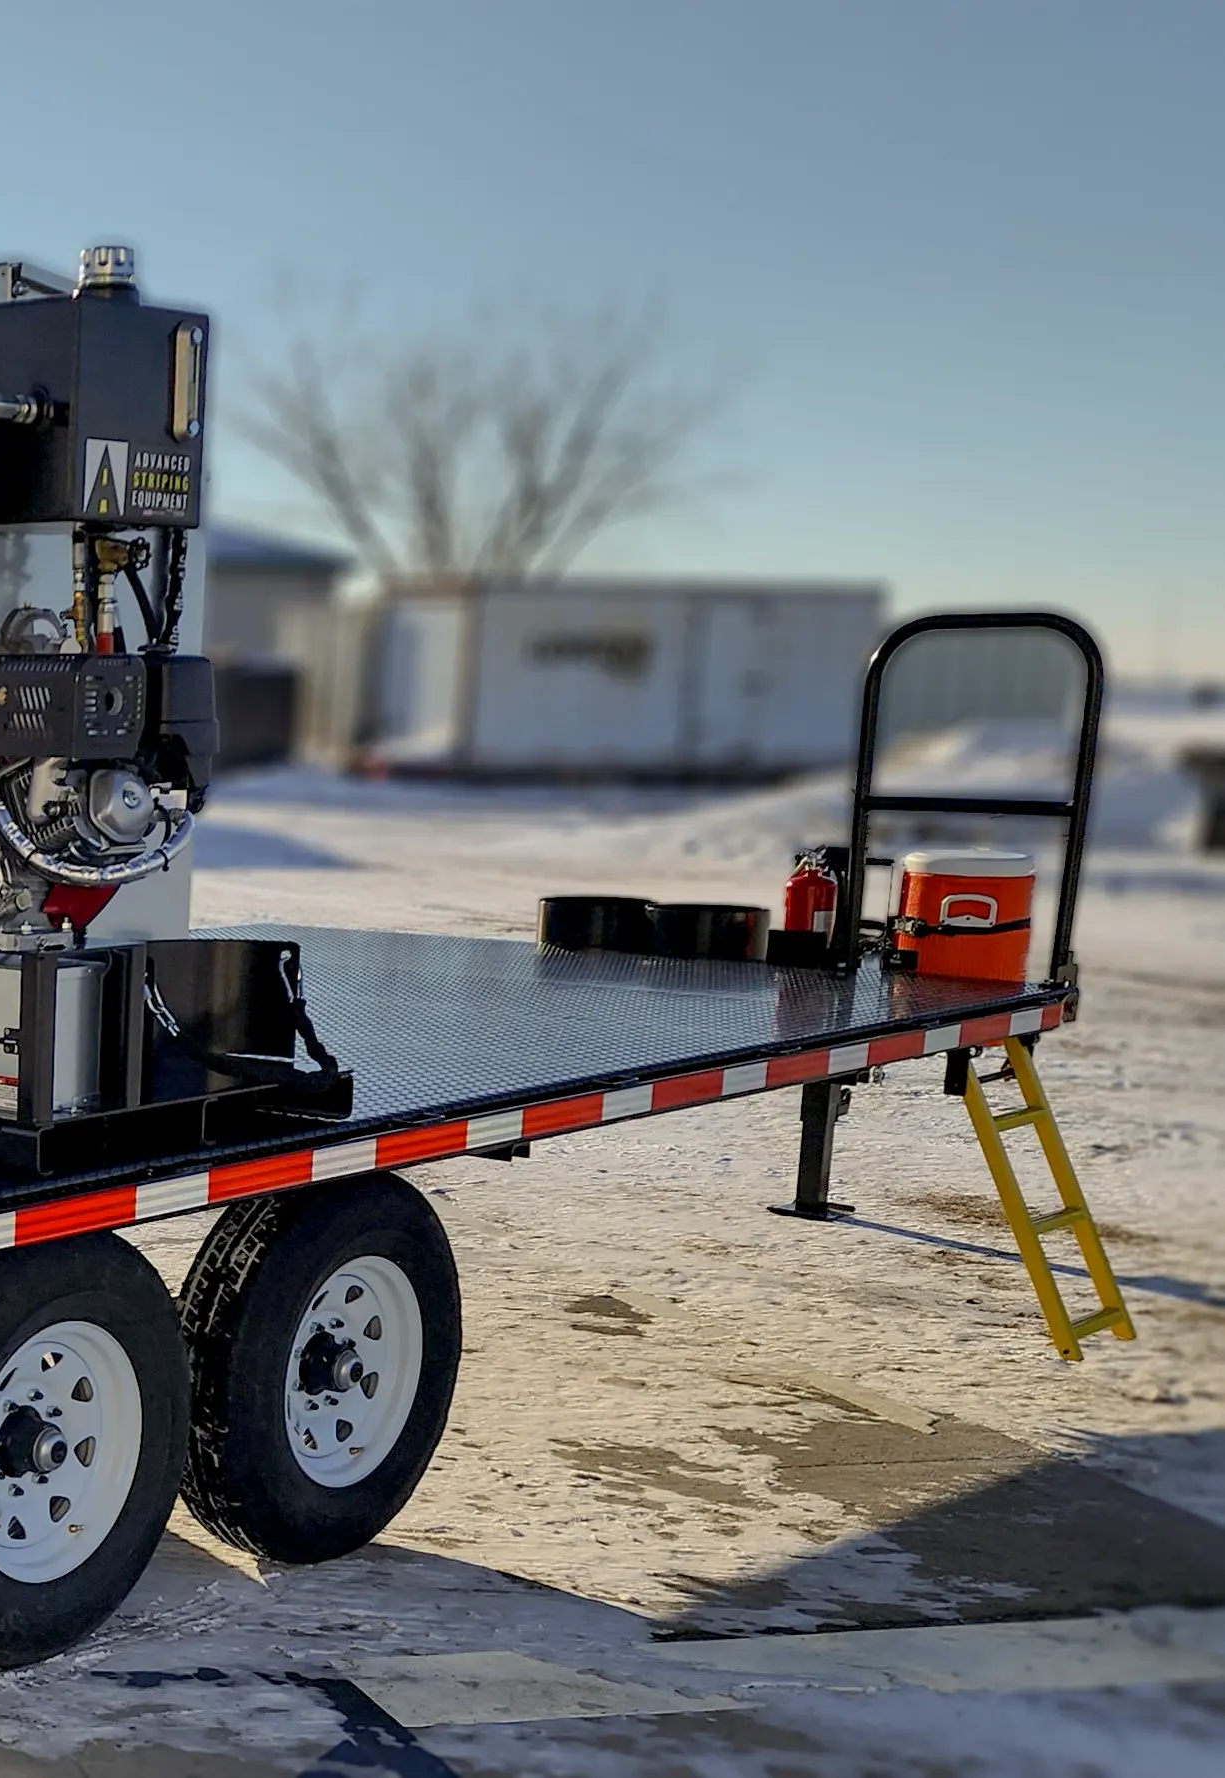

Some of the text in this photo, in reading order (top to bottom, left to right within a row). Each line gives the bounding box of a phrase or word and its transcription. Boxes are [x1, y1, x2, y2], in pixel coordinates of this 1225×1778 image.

[134, 452, 190, 472] ADVANCED
[133, 470, 189, 492] STRIPING
[131, 490, 189, 510] EQUIPMENT
